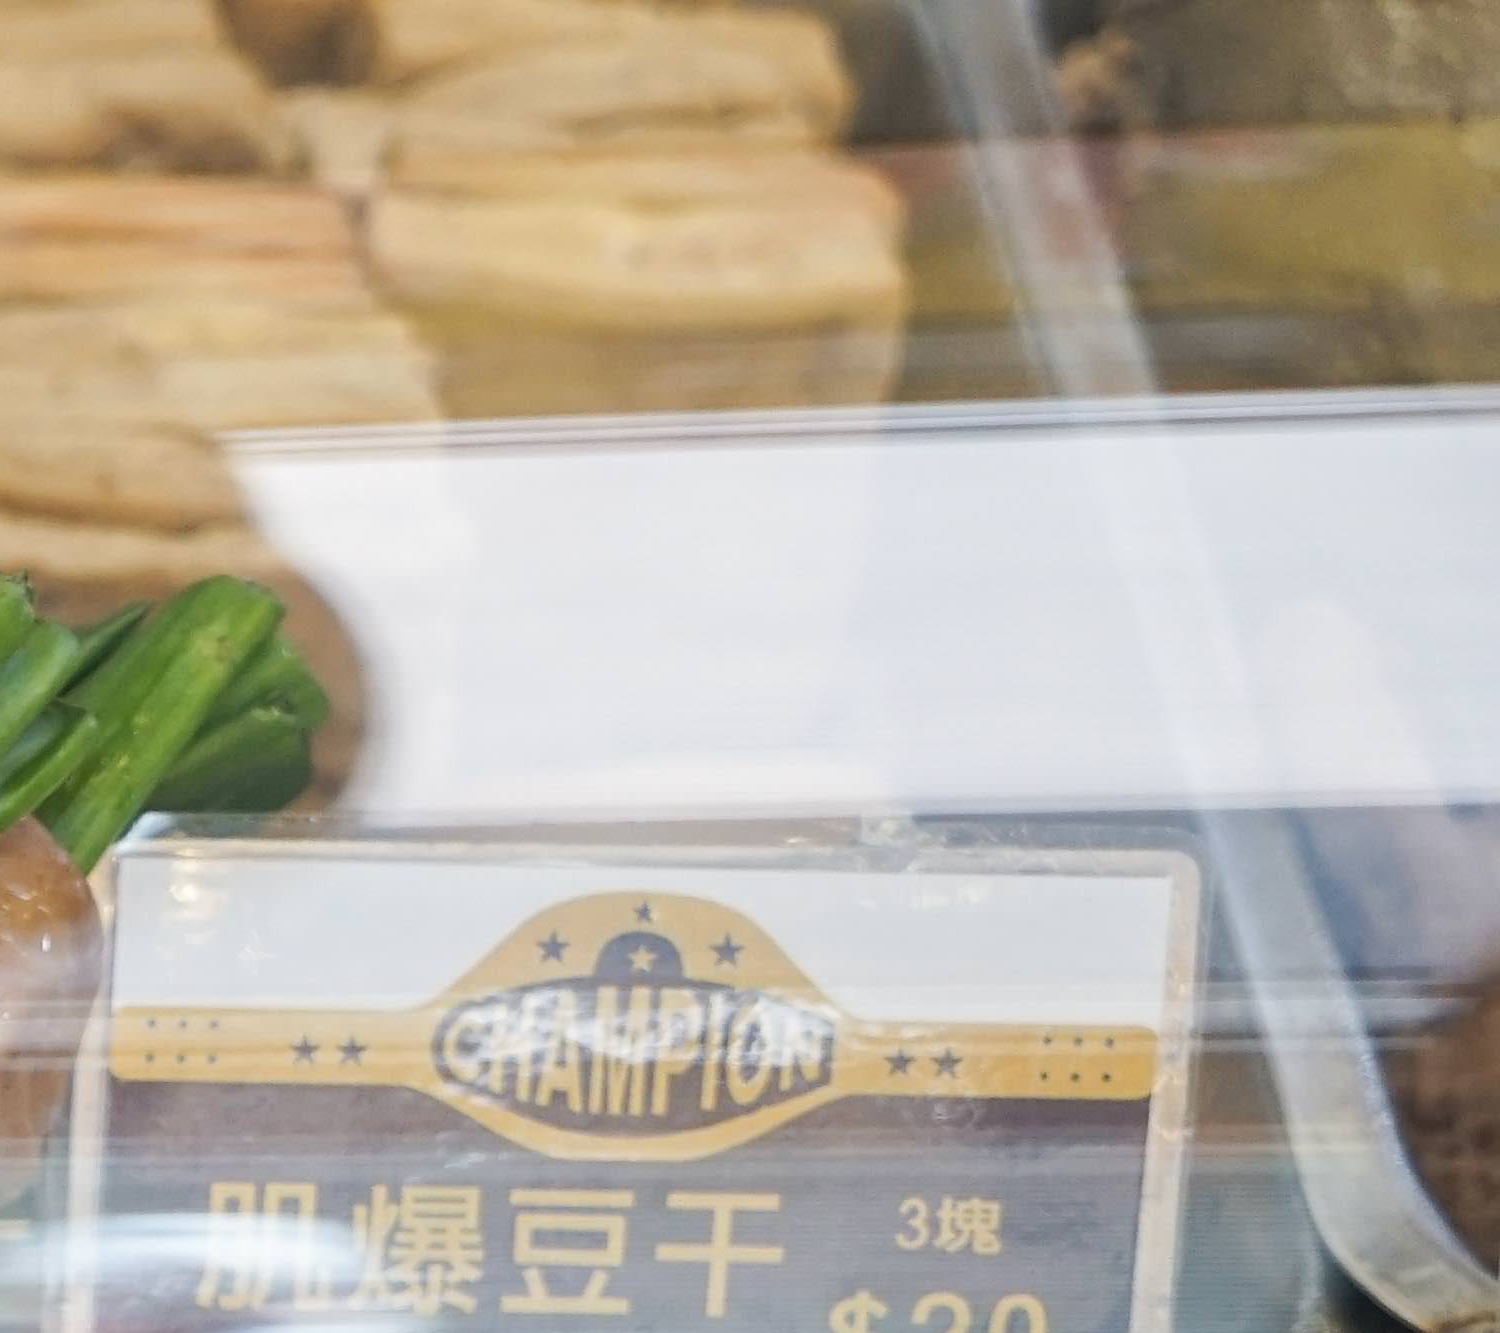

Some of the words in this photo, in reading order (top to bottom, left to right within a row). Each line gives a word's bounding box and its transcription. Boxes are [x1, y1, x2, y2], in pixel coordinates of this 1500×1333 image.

[444, 984, 826, 1117] CHAMPION
[195, 1180, 786, 1320] 肌爆豆干
[893, 1194, 1003, 1256] 3塊
